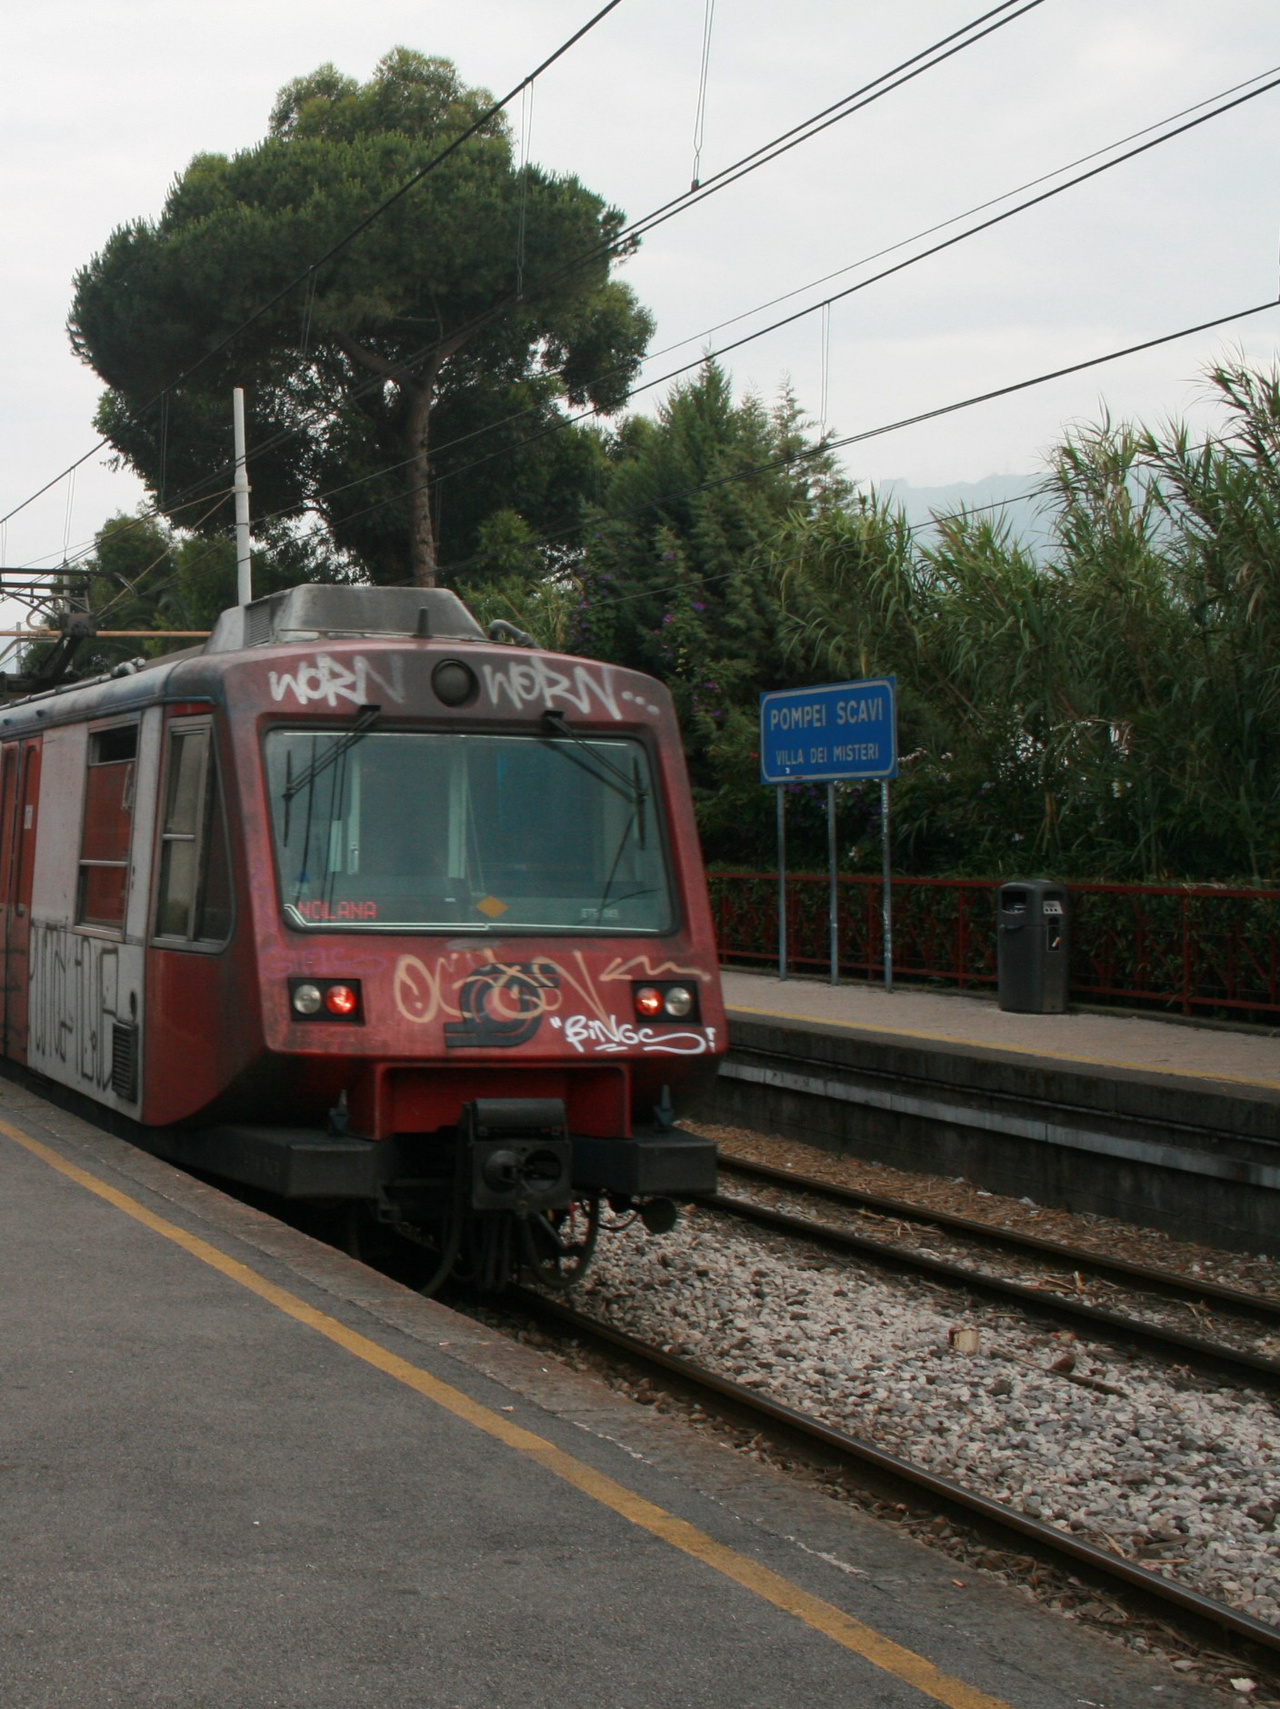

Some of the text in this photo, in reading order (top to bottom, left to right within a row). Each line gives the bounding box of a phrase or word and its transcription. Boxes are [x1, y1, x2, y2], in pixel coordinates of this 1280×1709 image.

[770, 697, 883, 731] POMPEI SCAVI
[775, 743, 879, 766] VILLA DEI MISTERI
[297, 901, 377, 919] NOLANA
